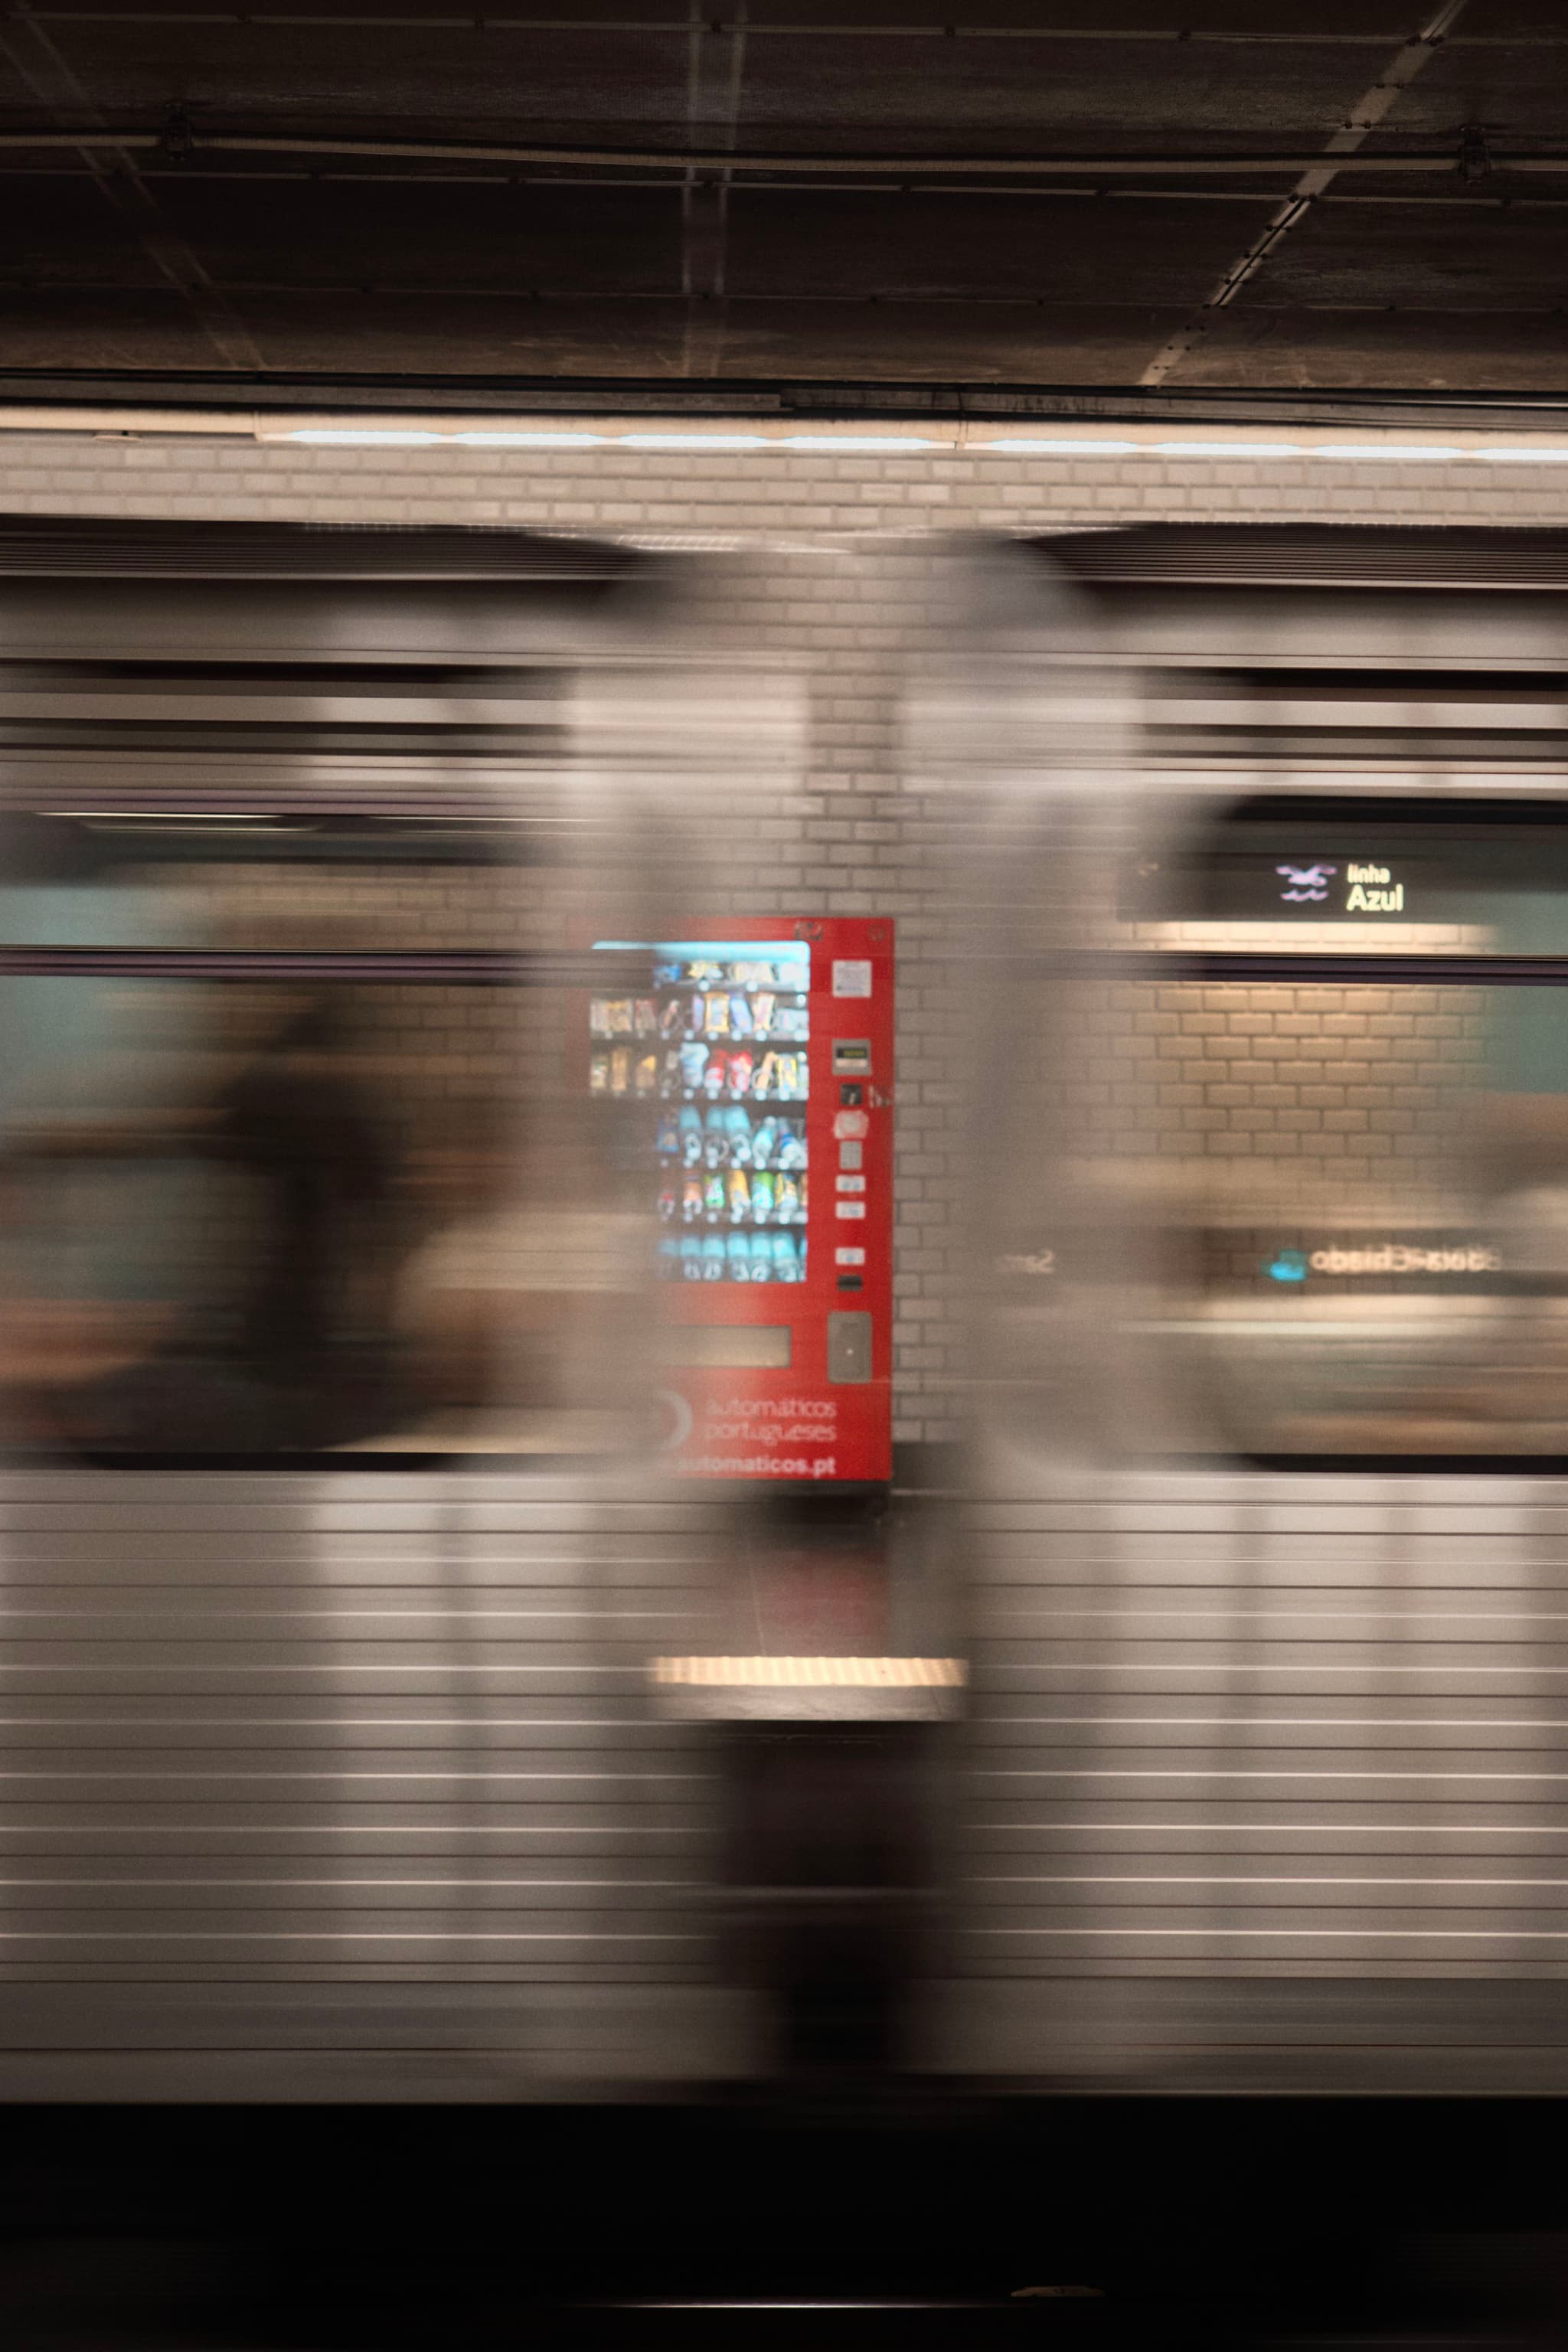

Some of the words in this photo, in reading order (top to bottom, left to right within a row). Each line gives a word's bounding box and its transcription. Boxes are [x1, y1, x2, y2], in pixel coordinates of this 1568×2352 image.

[1347, 863, 1391, 884] linha
[1346, 884, 1404, 911] Azul
[704, 1423, 838, 1446] portugueses
